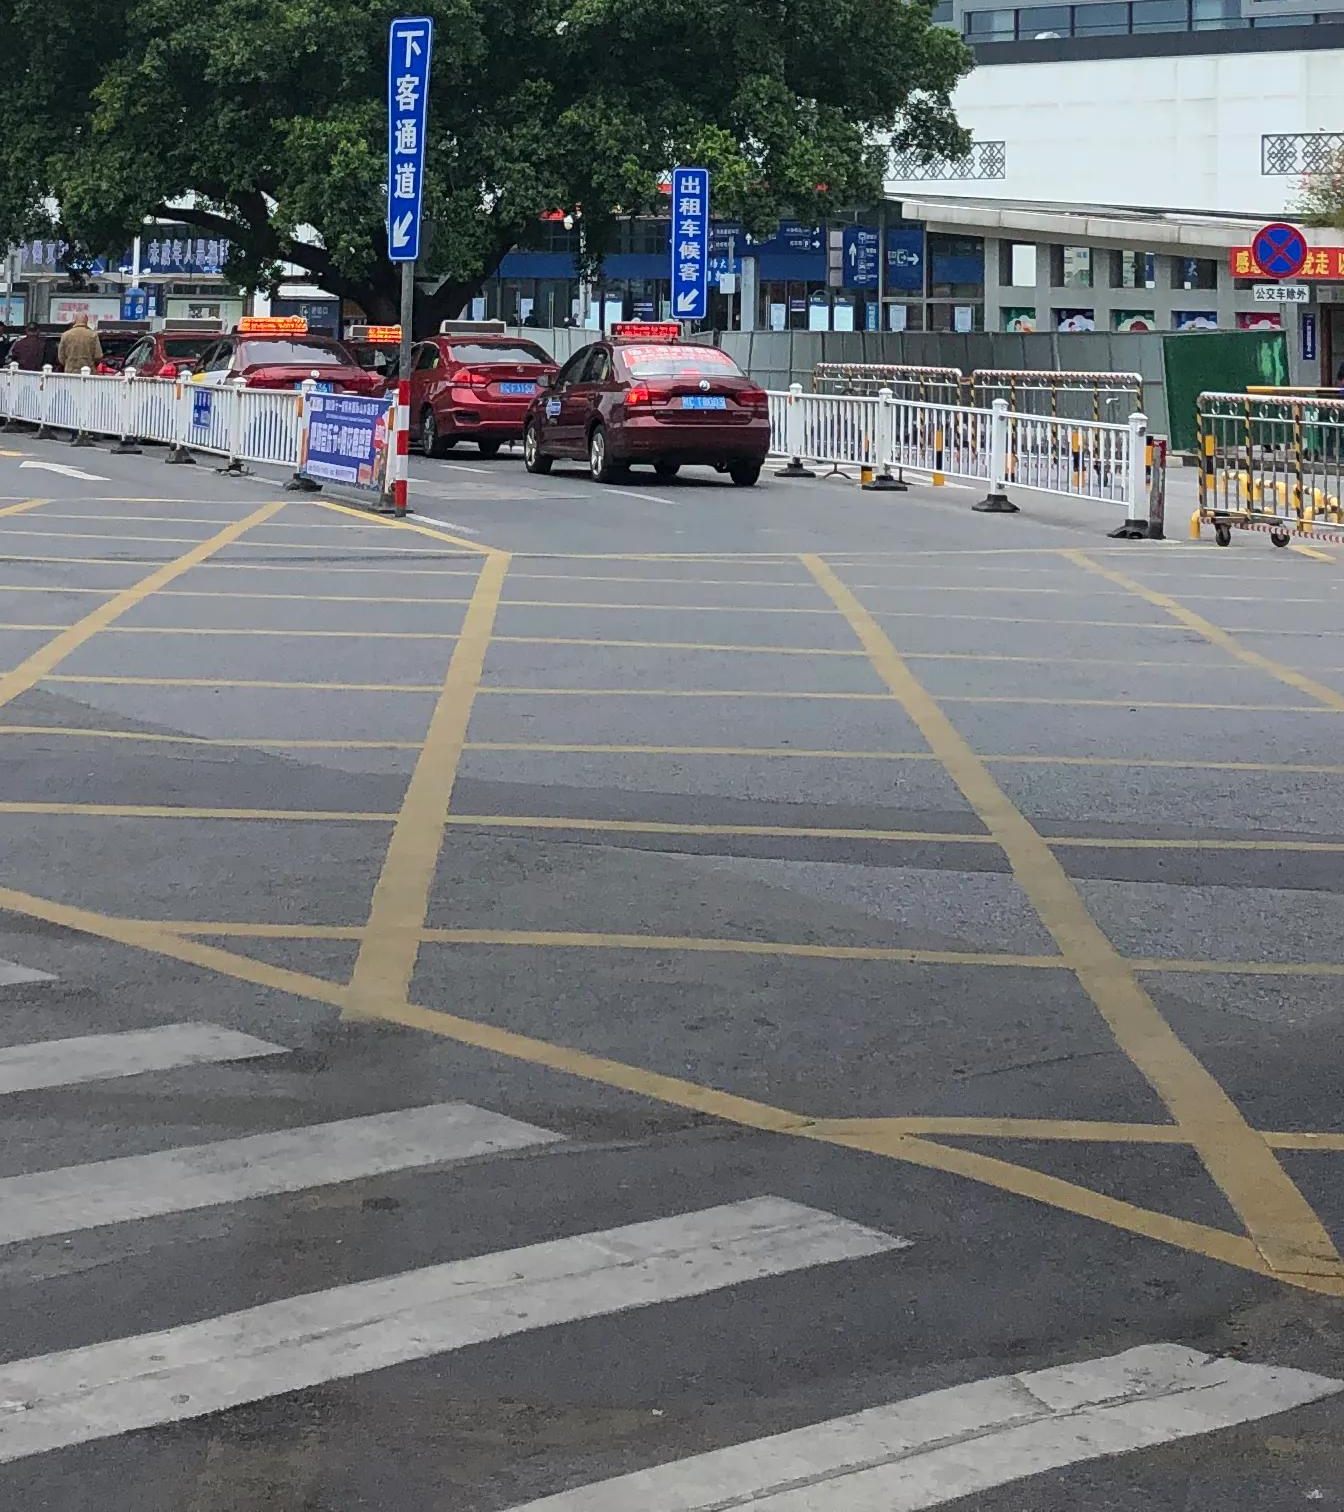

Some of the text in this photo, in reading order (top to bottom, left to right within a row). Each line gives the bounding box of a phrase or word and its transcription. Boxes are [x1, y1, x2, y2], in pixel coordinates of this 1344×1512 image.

[395, 30, 424, 199] 下客通道
[678, 176, 702, 282] 出租车候客
[1256, 288, 1307, 301] 公交车除外
